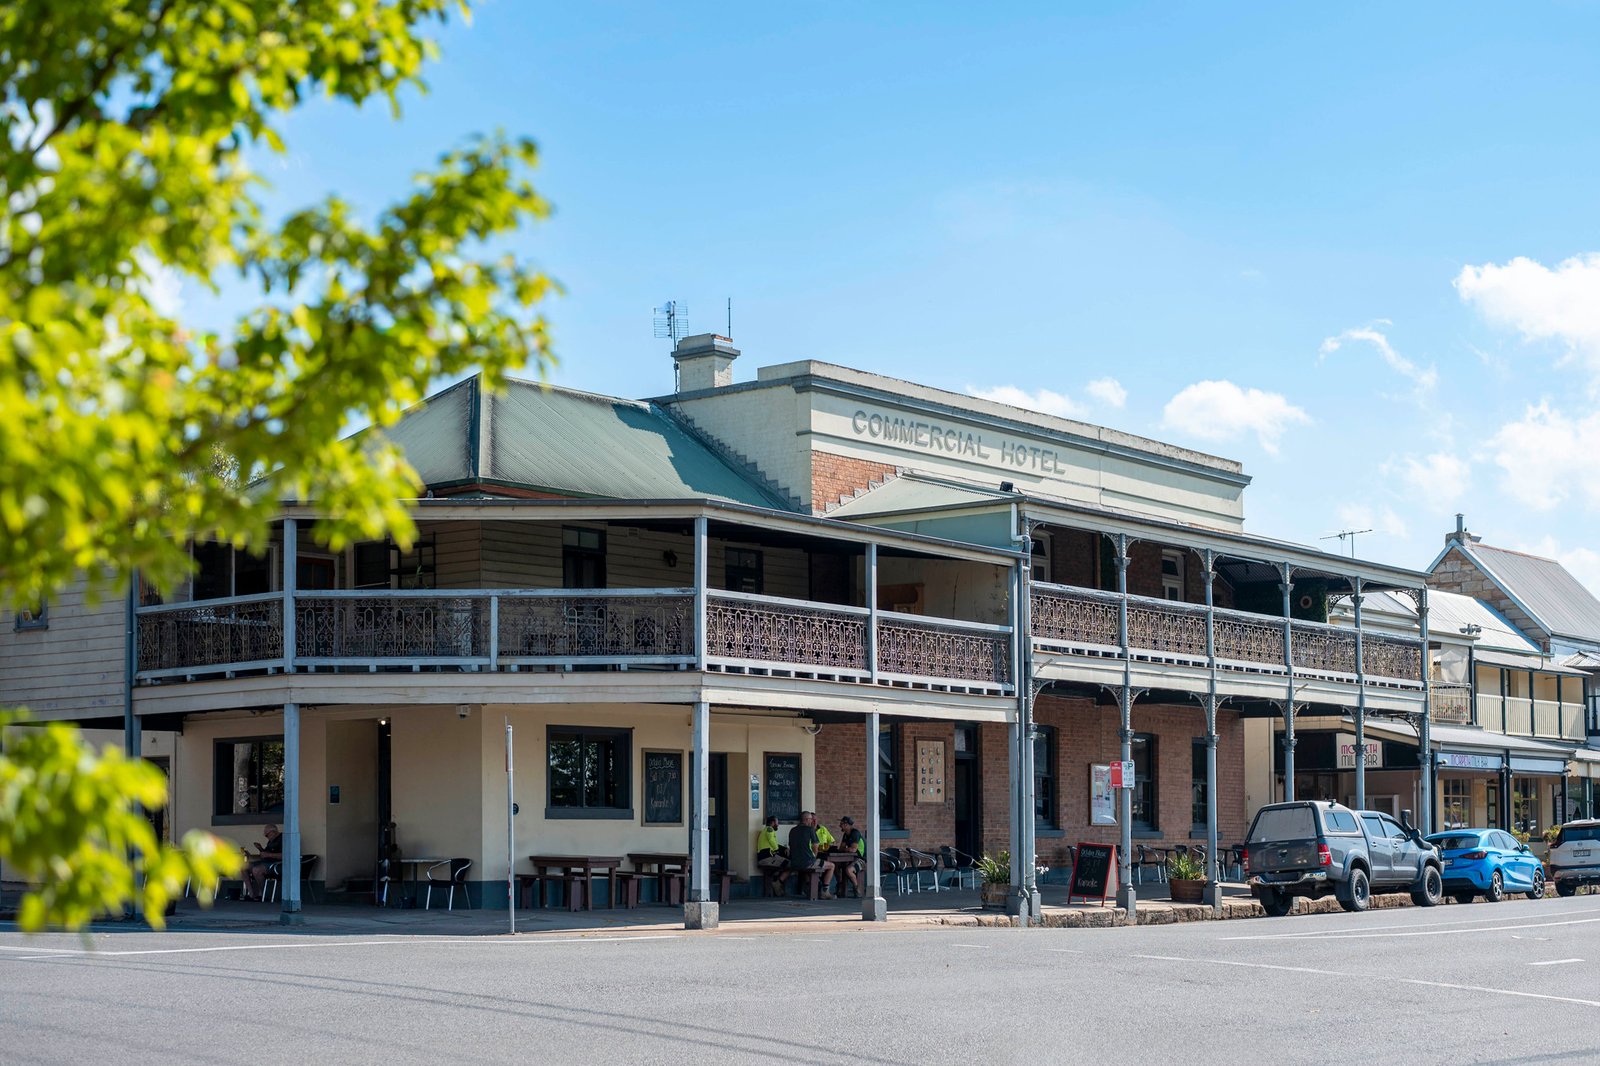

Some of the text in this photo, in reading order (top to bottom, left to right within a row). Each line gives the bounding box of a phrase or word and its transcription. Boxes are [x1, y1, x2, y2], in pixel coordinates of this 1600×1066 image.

[852, 410, 1066, 476] COMMERCIAL HOTEL
[1341, 744, 1378, 755] MOETH
[1341, 754, 1356, 767] MIL
